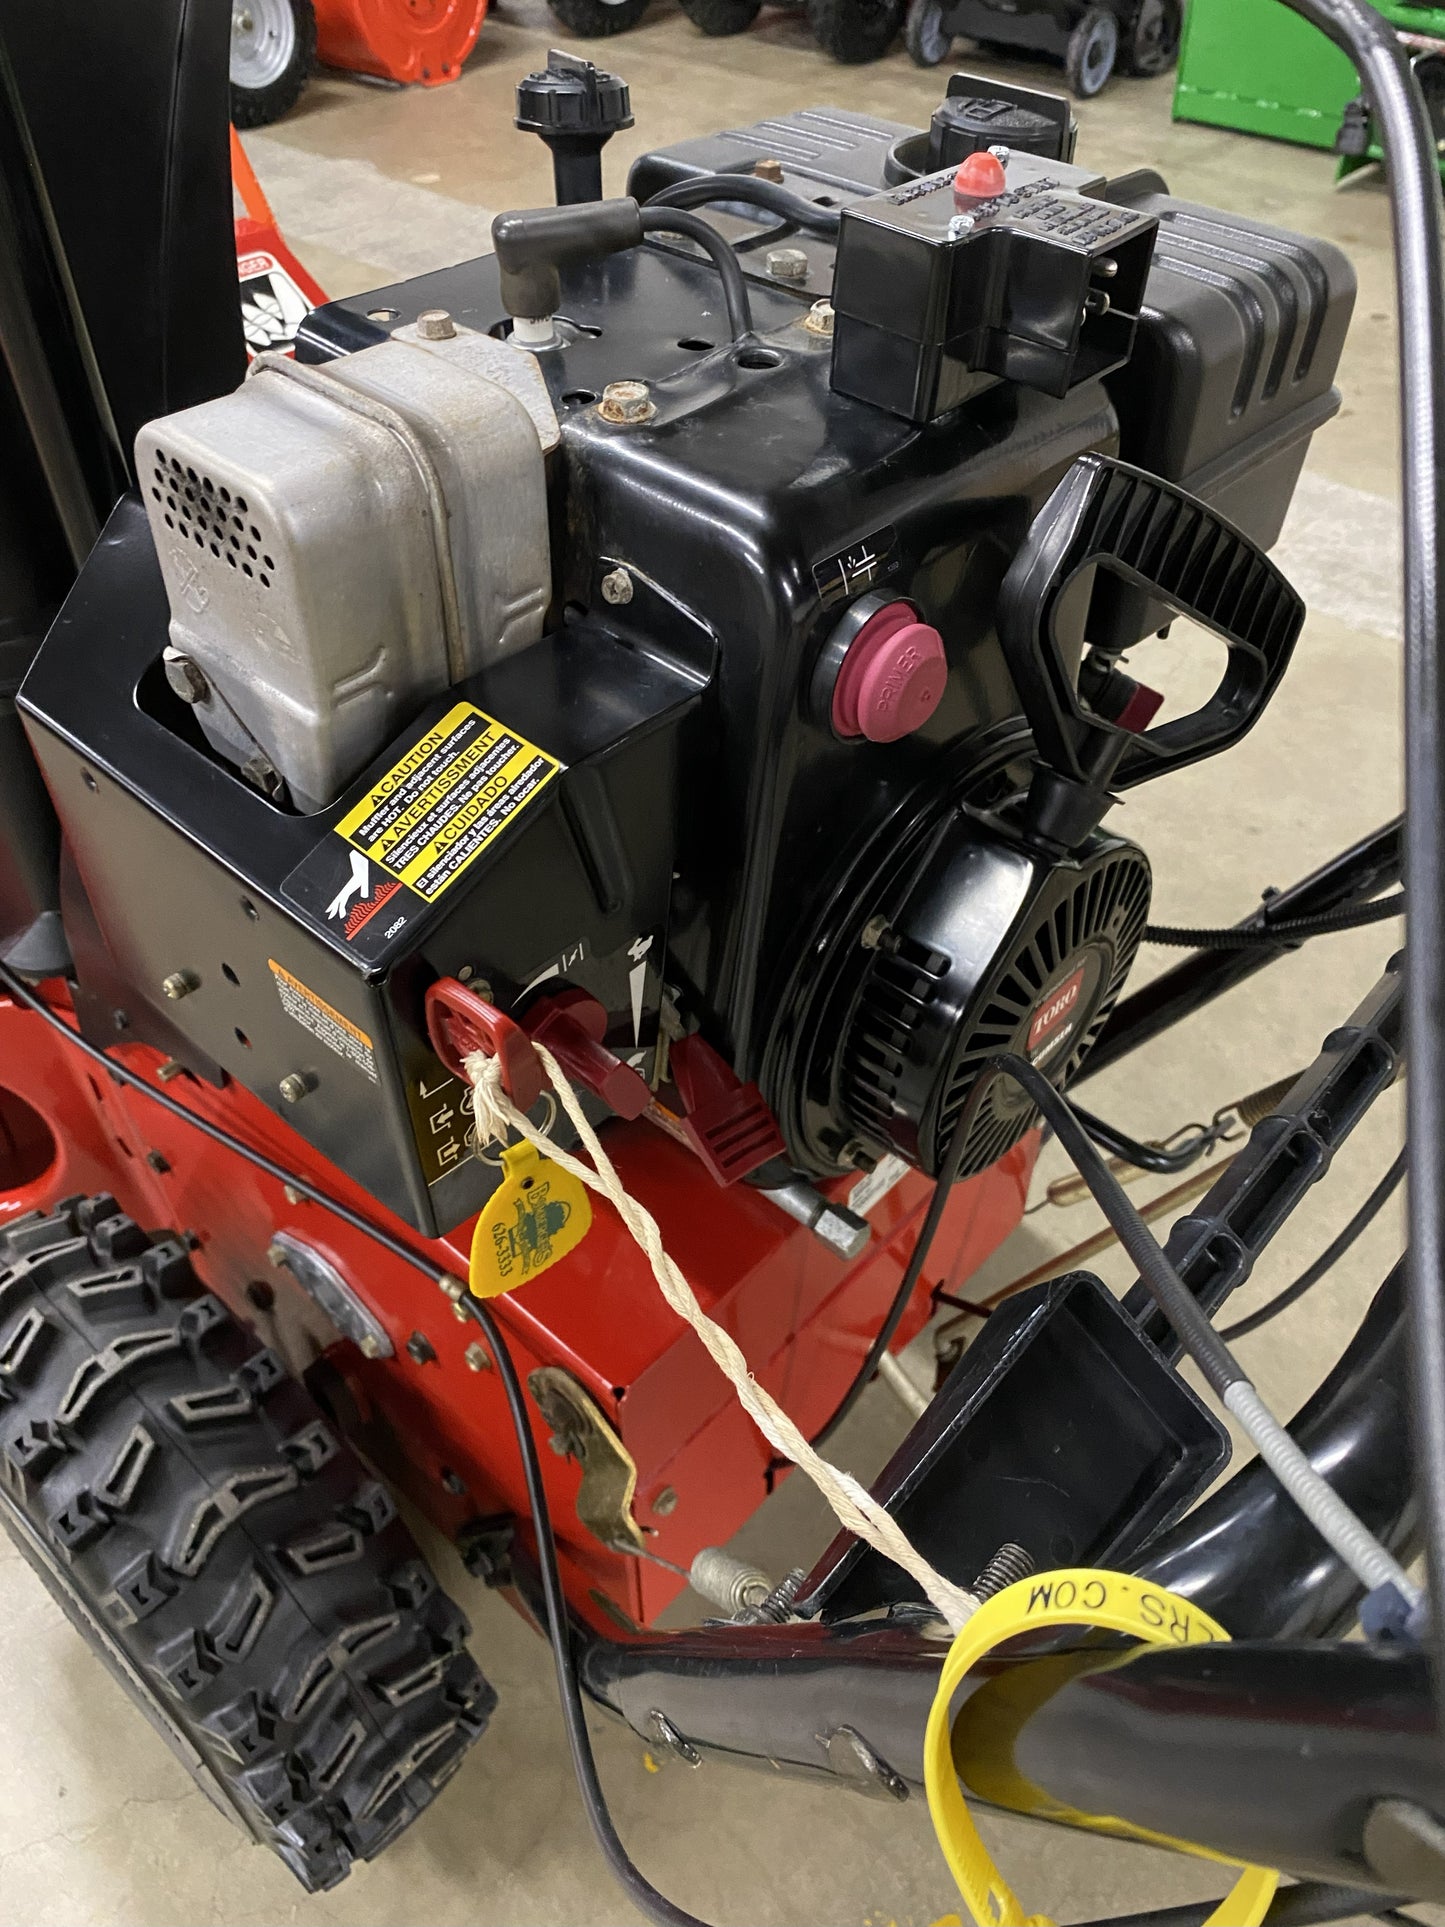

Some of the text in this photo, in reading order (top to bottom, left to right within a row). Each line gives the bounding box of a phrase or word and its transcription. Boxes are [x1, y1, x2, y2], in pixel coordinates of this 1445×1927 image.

[877, 645, 921, 712] PRIMER
[358, 719, 476, 836] Muffler and adjacent surfaces
[367, 751, 460, 842] are HOT. Do not touch.
[381, 732, 443, 793] CAUTION
[385, 737, 511, 864] Silencieux et surfaces adjacentes
[392, 744, 520, 869] TRES CHAUDES. Ne pas toucher.
[393, 731, 494, 838] AVERTISSMENT
[443, 776, 507, 839] CUIDADO
[415, 757, 544, 889] El silenciador y las áreas alredador
[425, 778, 540, 895] están CALIENTES. No tocar.
[384, 916, 408, 940] 2082
[1034, 985, 1077, 1035] TORO
[492, 1222, 513, 1277] 626-3333
